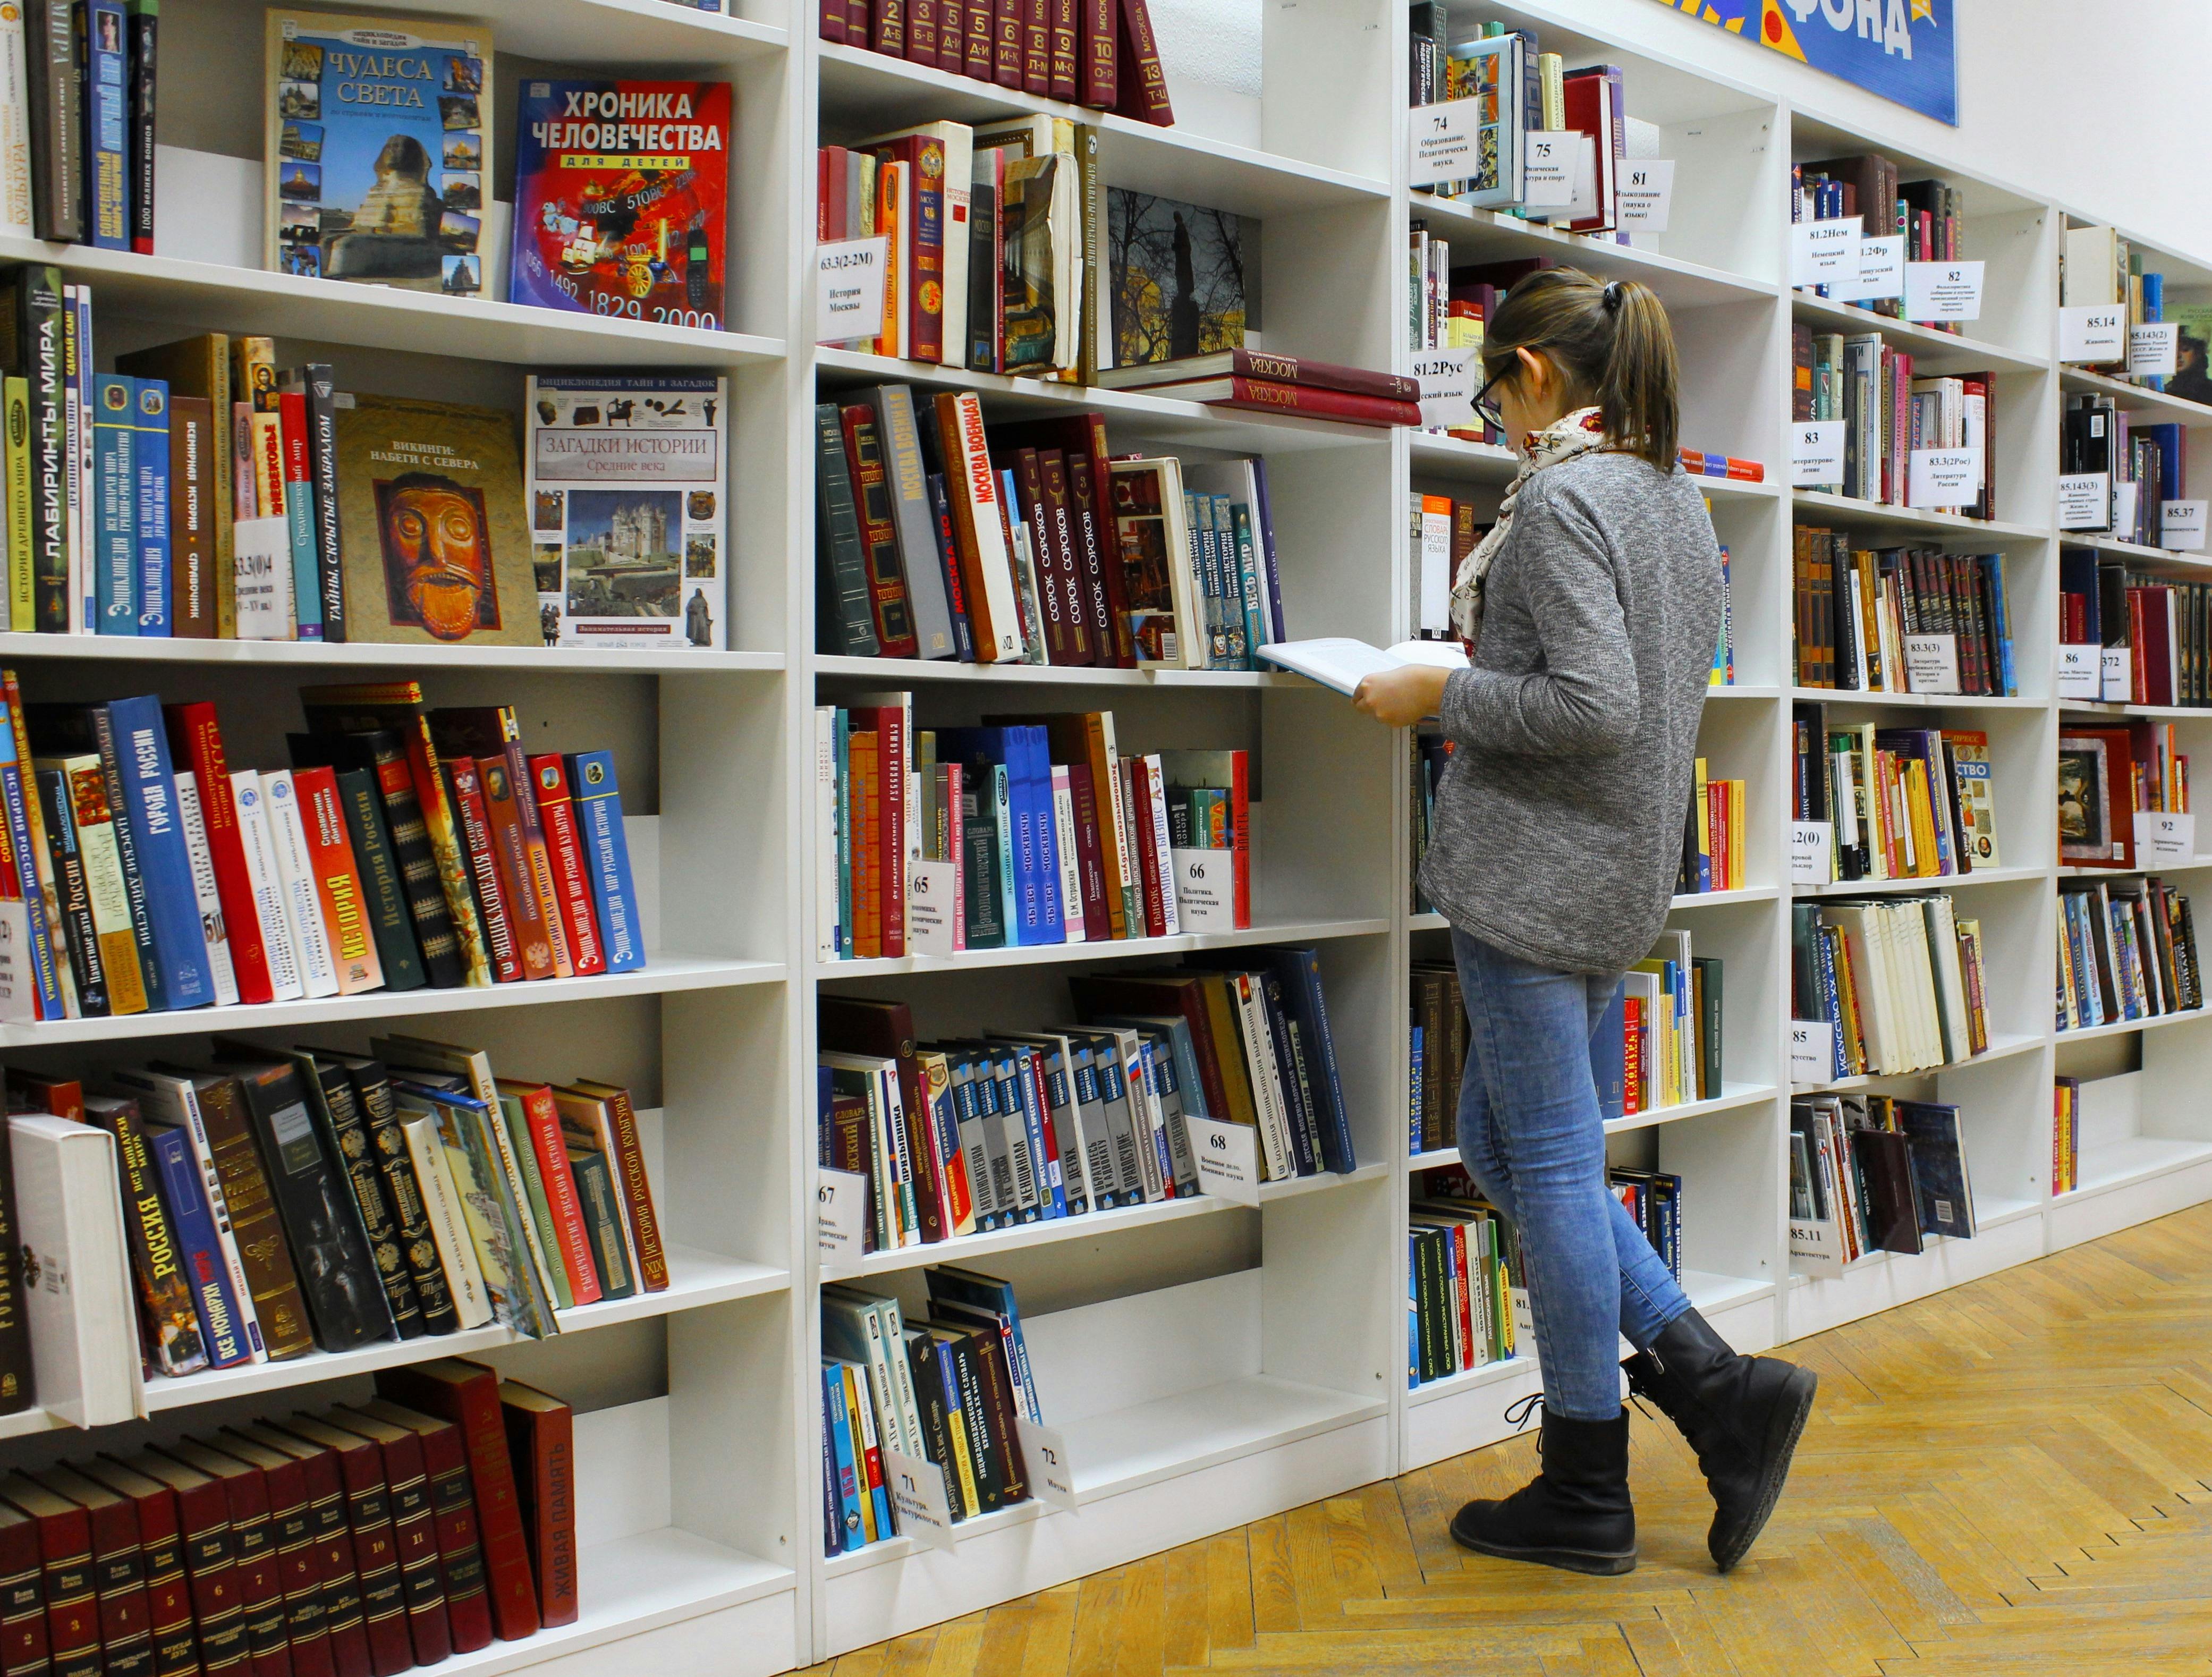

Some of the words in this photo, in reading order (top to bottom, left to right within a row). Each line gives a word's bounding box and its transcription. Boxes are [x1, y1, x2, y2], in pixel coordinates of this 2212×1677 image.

[886, 1, 899, 20] 2
[919, 2, 930, 19] 3
[974, 16, 985, 33] 5
[1005, 24, 1015, 40] 6
[1138, 6, 1152, 52] МОСКВА
[1034, 33, 1044, 49] 8
[1061, 36, 1071, 52] 9
[1095, 42, 1112, 58] 10
[329, 53, 434, 80] ЧУДЕСА
[1143, 65, 1160, 80] 13
[337, 82, 425, 108] СВЕТА
[564, 91, 692, 119] ХРОНИКА
[1434, 117, 1447, 130] 74
[531, 122, 722, 151] ЧЕЛОВЕЧЕСТВА
[1421, 136, 1465, 147] Образование.
[1536, 144, 1550, 158] 75
[565, 157, 605, 167] ДЛЯ
[622, 157, 684, 167] ДЕТЕЙ
[1433, 159, 1454, 168] наука.
[1632, 172, 1646, 185] 81
[141, 202, 152, 230] 1000
[1625, 210, 1647, 219] языке)
[1810, 227, 1849, 240] 81.2Нем
[821, 252, 872, 270] 63.3(2-2М)
[1811, 249, 1845, 259] Немецкий
[550, 269, 578, 303] 1492
[1948, 271, 1961, 282] 82
[829, 288, 861, 300] История
[589, 290, 642, 318] 1829
[829, 302, 860, 314] Москвы
[2087, 316, 2115, 329] 85.14
[2130, 330, 2167, 341] 85.143(2)
[39, 319, 57, 395] МИРА
[1249, 358, 1298, 378] МОСКВА
[1413, 359, 1464, 377] 81.2Рус
[539, 378, 622, 387] ЭНЦИКЛОПЕДИЯ
[627, 378, 654, 387] ТАЙН
[671, 378, 715, 388] ЗАГАДОК
[962, 397, 985, 452] ВОЕННАЯ
[546, 438, 623, 454] ЗАГАДКИ
[628, 438, 707, 454] ИСТОРИИ
[1805, 432, 1818, 444] 83
[186, 421, 197, 481] ВСЕМИРНАЯ
[392, 441, 455, 456] ВИКИНГИ:
[370, 451, 419, 464] НАБЕГИ
[422, 456, 431, 465] С
[434, 456, 479, 470] СЕВЕРА
[587, 459, 637, 473] Средние
[641, 461, 666, 472] века
[1929, 457, 1971, 467] 83.3(2Рос)
[42, 402, 61, 557] ЛАБИРИНТЫ
[970, 453, 995, 504] МОСКВА
[2061, 482, 2098, 491] 85.143(3)
[18, 487, 28, 546] ДРЕВНЕГО
[188, 486, 197, 530] ИСТОРИЯ
[2167, 508, 2194, 518] 85.37
[1034, 503, 1051, 568] СОРОКОВ
[1423, 524, 1448, 535] СЛОВАРЬ
[1056, 508, 1073, 571] СОРОКОВ
[1082, 511, 1099, 575] СОРОКОВ
[1423, 535, 1448, 545] РУССКОГО
[1428, 544, 1446, 554] ЯЗЫКА
[1202, 531, 1212, 571] ИСТОРИЯ
[1221, 532, 1230, 573] ИСТОРИЯ
[1242, 543, 1255, 573] МИР
[1227, 532, 1239, 597] ЦИВИЛИЗАЦИИ
[20, 548, 29, 605] ИСТОРИЯ
[189, 553, 199, 619] СПРАВОЧНИК
[1045, 573, 1060, 622] СОРОК
[1066, 576, 1081, 624] СОРОК
[1244, 575, 1259, 611] ВЕСЬ
[1092, 580, 1107, 628] СОРОК
[1862, 555, 1877, 651] ГОГОЛЬ
[1911, 643, 1940, 654] 83.3(3)
[2066, 654, 2078, 663] 86
[132, 728, 159, 778] РОССИИ
[313, 792, 332, 847] Справочник
[323, 787, 341, 844] абитуриента
[6, 773, 26, 831] ИСТОРИЯ
[21, 834, 35, 887] РОССИИ
[1154, 806, 1167, 850] БИЗНЕС
[1238, 812, 1249, 851] ВЛАСТЬ
[2162, 821, 2173, 831] 92
[1020, 812, 1032, 873] МОСКВИЧИ
[1039, 812, 1051, 872] МОСКВИЧИ
[1190, 863, 1205, 879] 66
[914, 875, 928, 893] 65
[1183, 887, 1213, 896] Политика.
[1158, 862, 1175, 926] ЭКОНОМИКА
[1179, 897, 1219, 907] Политическая
[473, 851, 513, 960] ЭНЦИКЛОПЕДИЯ
[1071, 901, 1079, 916] О.М.
[326, 873, 367, 961] ИСТОРИЯ
[1028, 909, 1036, 926] МЫ
[1047, 909, 1055, 925] МЫ
[1793, 1031, 1807, 1043] 85
[1833, 1001, 1847, 1071] ИСКУССТВО
[1626, 1034, 1639, 1098] СЛОВАРЬ
[615, 1096, 637, 1153] КУЛЬТУРЫ
[116, 1116, 139, 1171] МОНАРХИ
[894, 1104, 911, 1184] ПРИЗЫВНИКА
[1170, 1111, 1188, 1159] СОБСТВЕННИК
[1210, 1134, 1226, 1150] 68
[1088, 1141, 1101, 1192] ОБРАТИТЕСЬ
[1116, 1130, 1139, 1188] ПРАВОСУДИЕ
[131, 1172, 145, 1192] ВСЕ
[628, 1155, 648, 1206] РУССКОЙ
[973, 1144, 993, 1213] АВТОЛЮБИТЕЛЯМ
[1013, 1140, 1035, 1205] ЖЕНЩИНАМ
[1201, 1165, 1225, 1176] Военная
[1226, 1172, 1244, 1181] наука
[819, 1186, 835, 1205] 67
[903, 1182, 919, 1229] Справочник
[137, 1194, 177, 1280] РОССИЯ
[636, 1207, 658, 1256] ИСТОРИЯ
[1791, 1229, 1821, 1241] 85.11
[1790, 1251, 1830, 1260] Архитектура
[646, 1261, 665, 1274] XIX
[1043, 1448, 1056, 1465] 72
[548, 1442, 567, 1525] ПАМЯТЬ
[902, 1475, 916, 1493] 71
[1047, 1478, 1067, 1493] Наука
[896, 1492, 928, 1511] Культура.
[372, 1540, 385, 1554] 10
[412, 1532, 424, 1545] 11
[547, 1528, 571, 1598] ЖИВАЯ
